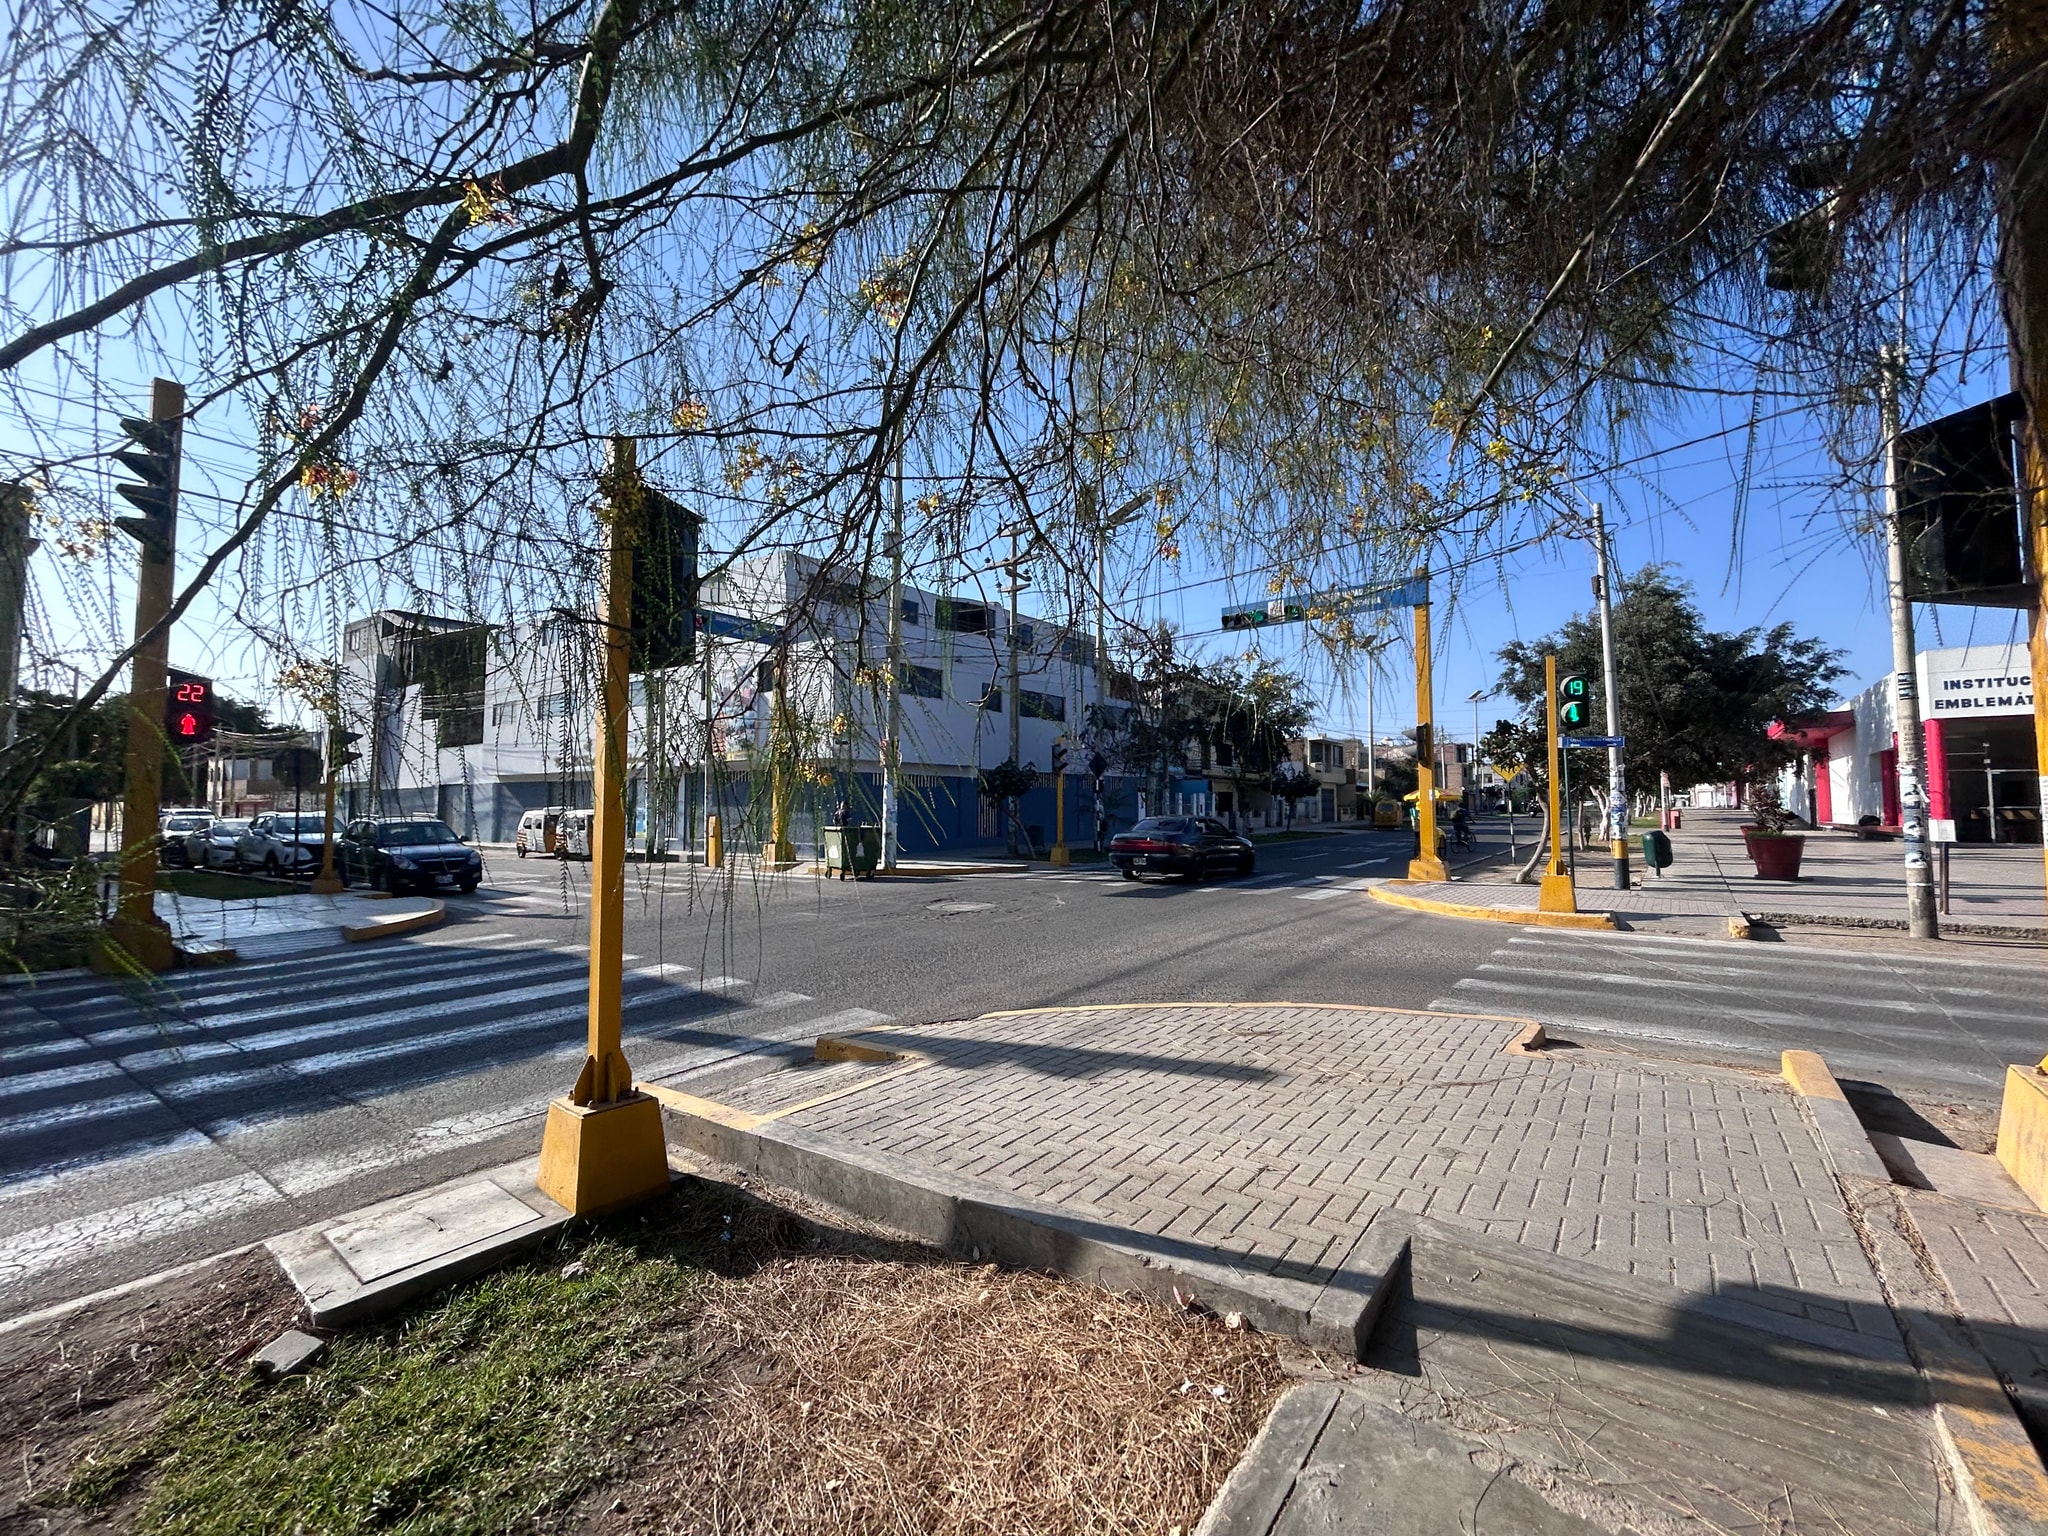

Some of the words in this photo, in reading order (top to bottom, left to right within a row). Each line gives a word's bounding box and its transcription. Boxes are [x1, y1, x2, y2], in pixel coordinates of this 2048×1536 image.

[1570, 680, 1583, 695] 19
[1943, 676, 2032, 690] INSTITUC
[177, 684, 204, 702] 22
